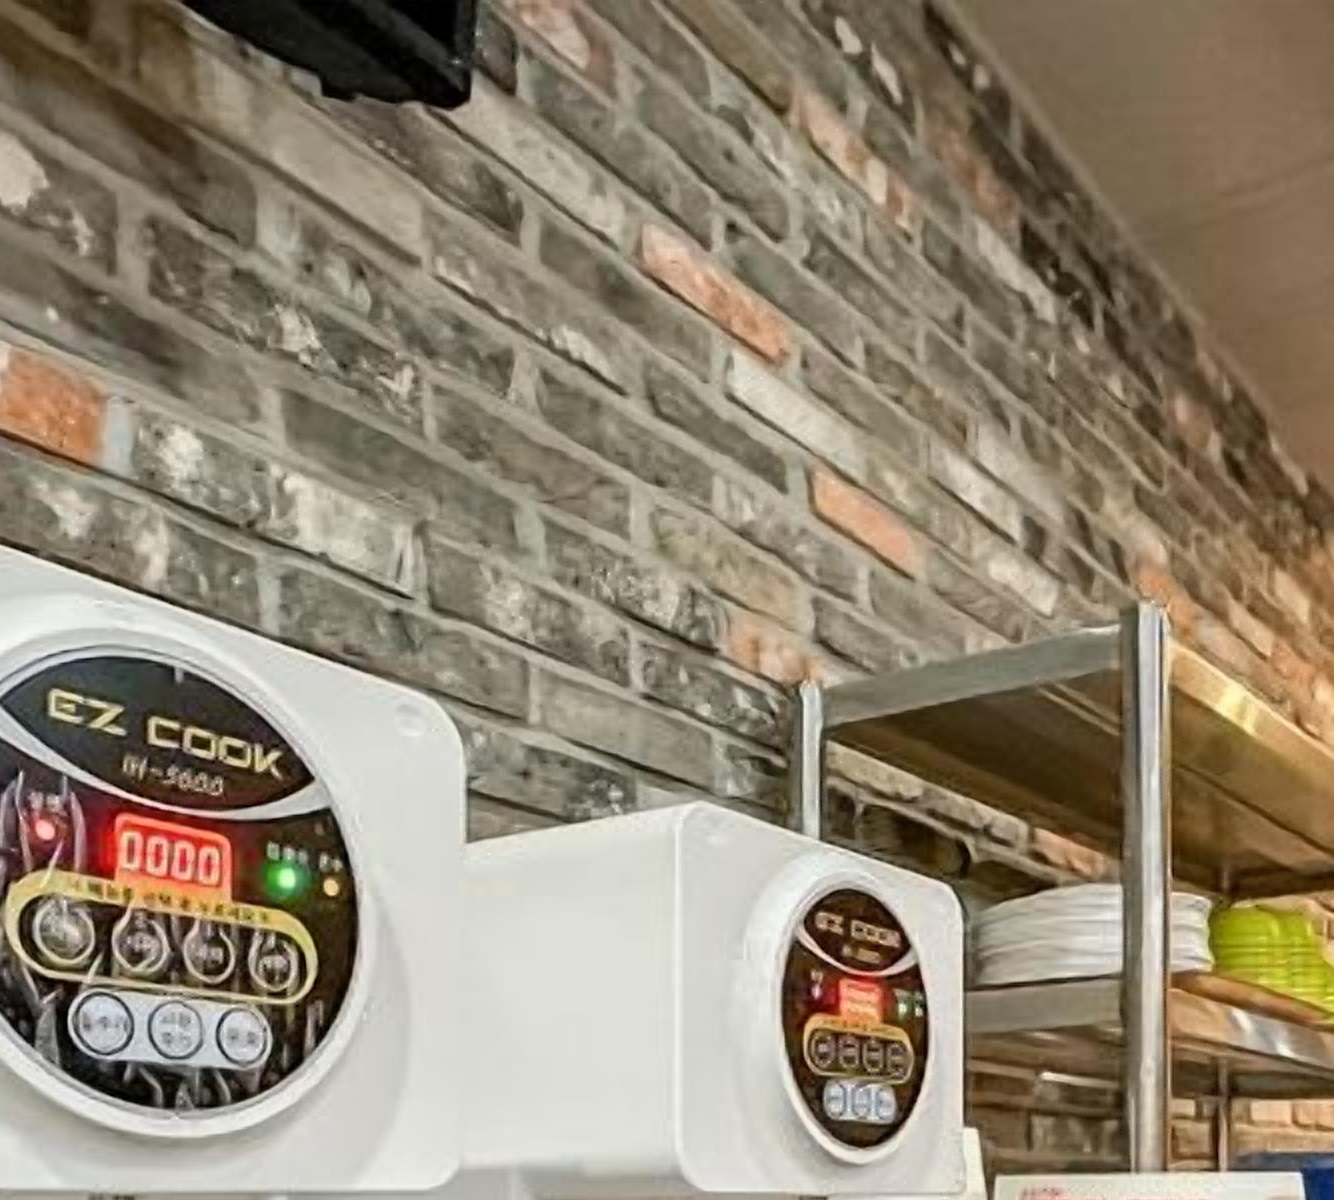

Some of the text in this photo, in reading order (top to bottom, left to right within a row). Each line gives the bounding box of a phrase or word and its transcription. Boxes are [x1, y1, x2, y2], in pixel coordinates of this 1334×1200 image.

[48, 688, 284, 780] EZ COOK
[120, 831, 219, 886] 0000
